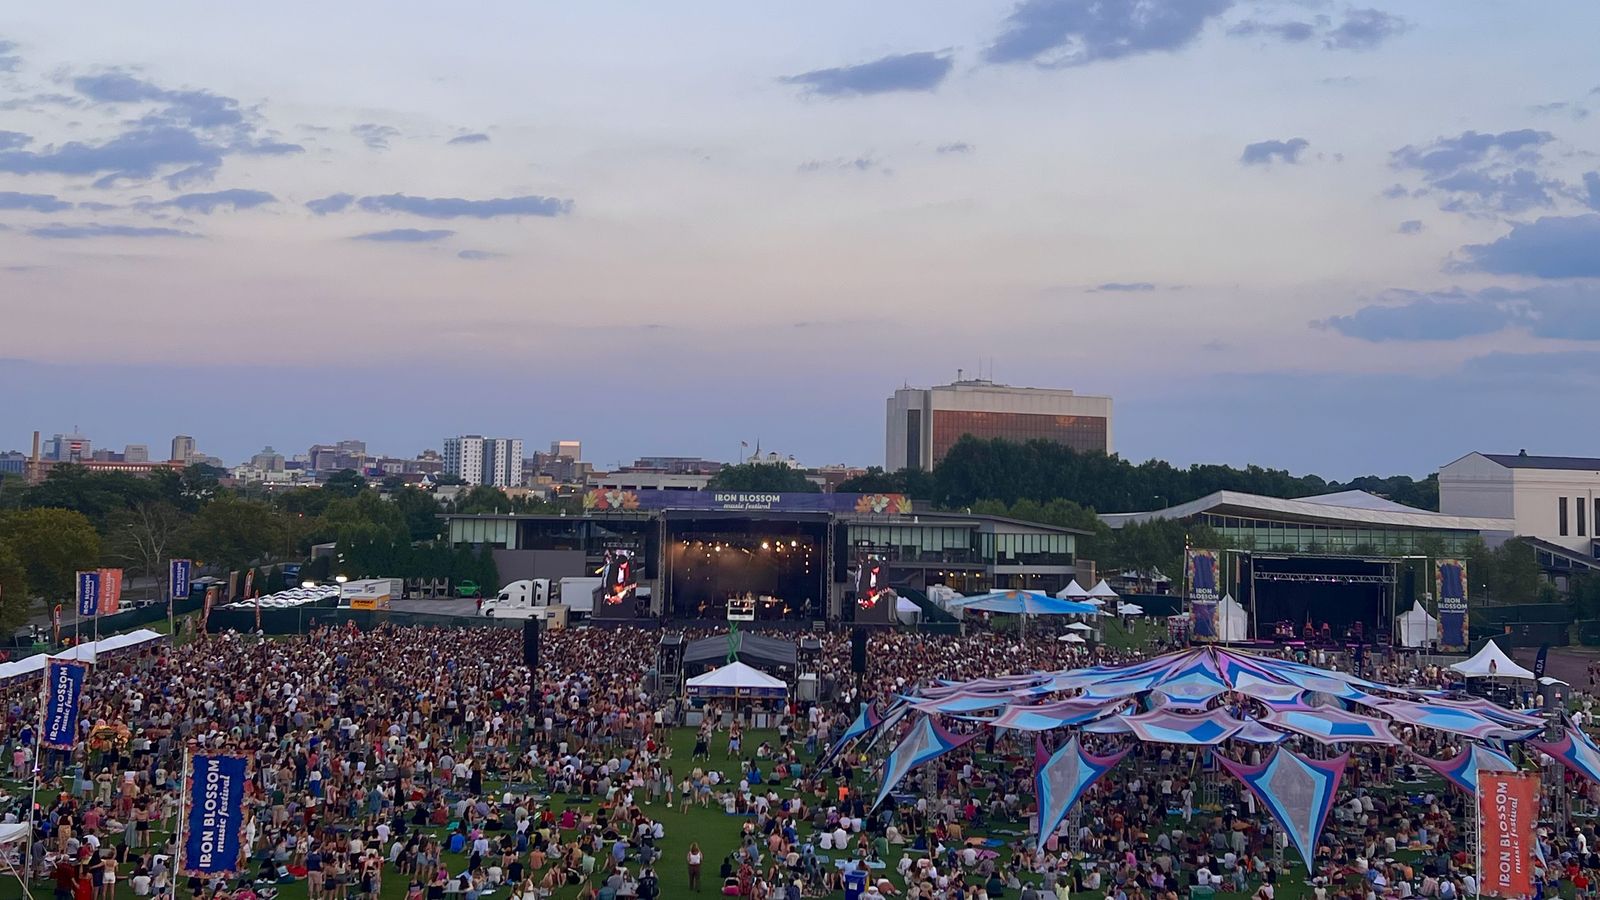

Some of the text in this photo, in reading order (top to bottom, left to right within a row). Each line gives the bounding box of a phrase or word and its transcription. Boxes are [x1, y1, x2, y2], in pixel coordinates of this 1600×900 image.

[715, 494, 780, 503] IRON BLOSSOM
[745, 502, 771, 510] festival
[50, 666, 68, 741] IRON BLOSSOM
[1536, 659, 1544, 673] ADA
[61, 678, 73, 732] music festival
[199, 759, 220, 868] IRON BLOSSOM
[216, 774, 230, 853] music festival
[1496, 782, 1511, 887] IRON BLOSSOM
[1508, 796, 1521, 874] music festival
